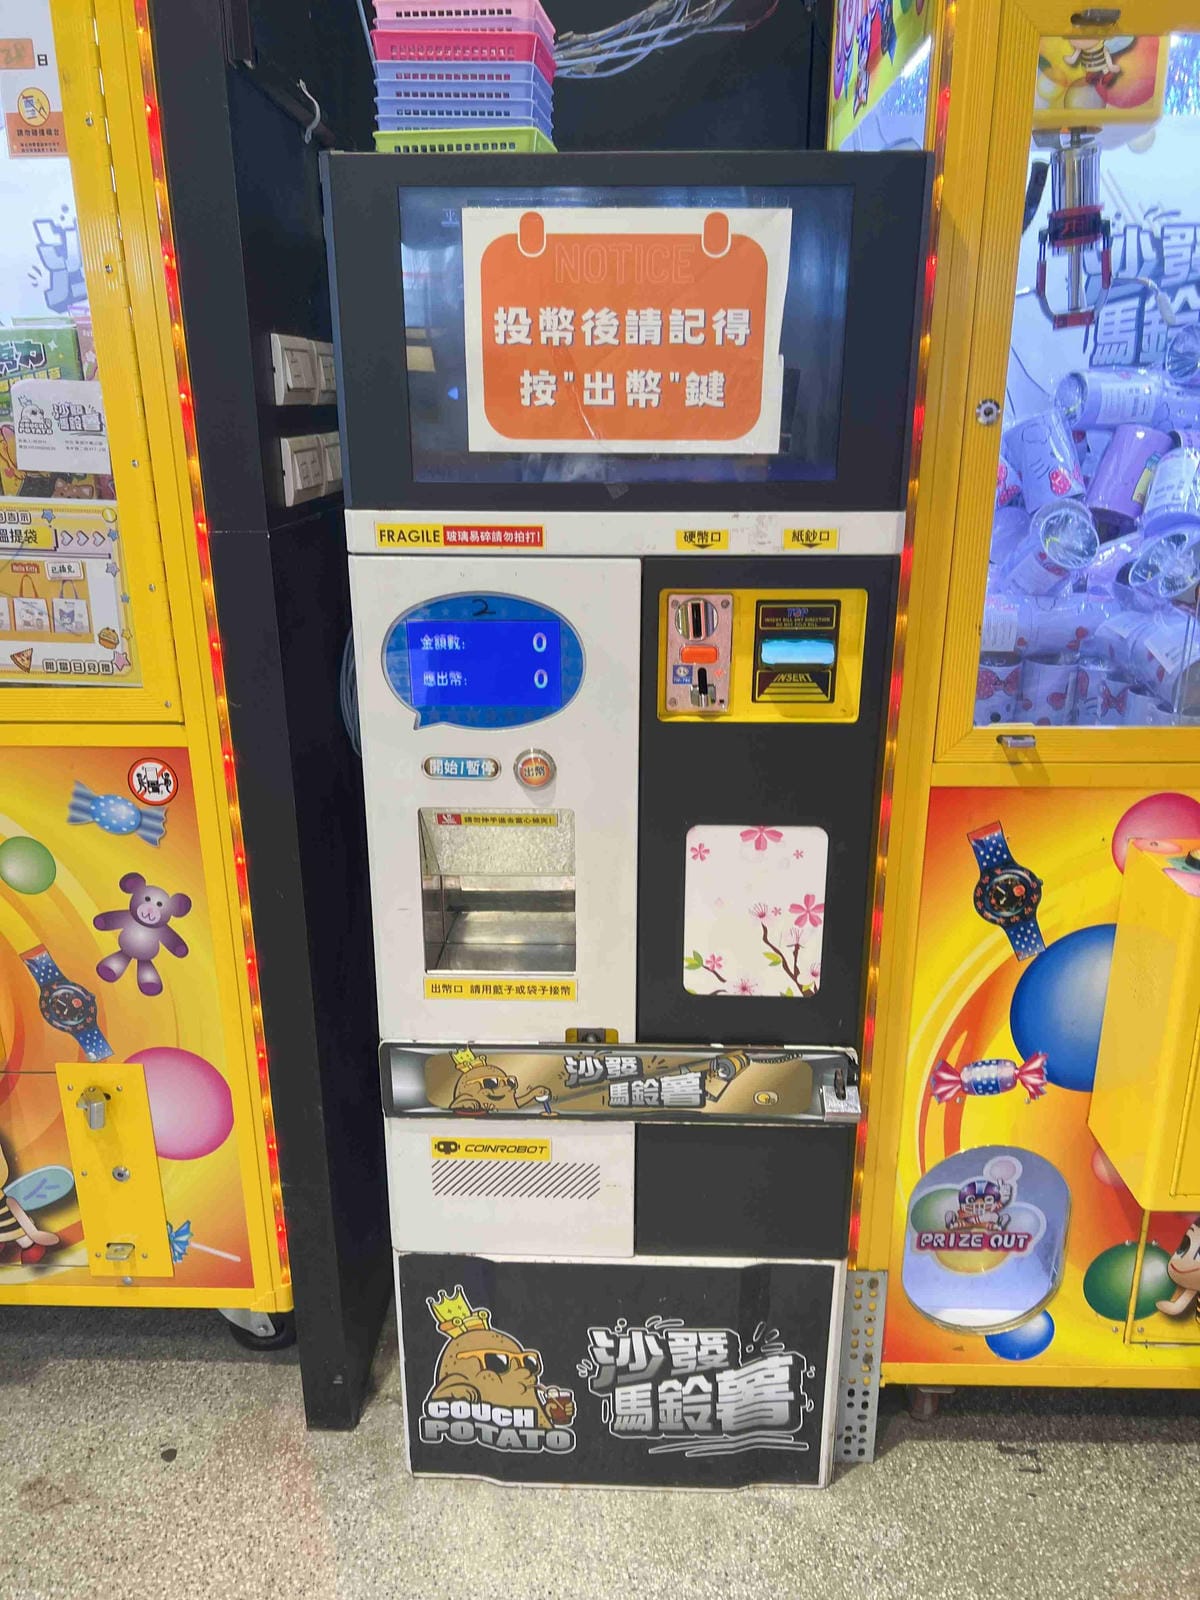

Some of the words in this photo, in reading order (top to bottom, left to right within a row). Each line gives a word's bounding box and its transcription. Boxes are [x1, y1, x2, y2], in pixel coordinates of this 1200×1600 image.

[554, 242, 696, 285] NOTICE
[493, 306, 751, 347] 投幣後請記得
[519, 369, 727, 409] 按"出幣"鍵
[379, 529, 441, 543] FRAGILE
[446, 531, 541, 543] 玻璃易碎請勿拍打!
[683, 530, 721, 543] 硬幣口
[792, 528, 830, 542] 紙鈔口
[472, 598, 496, 617] 2
[532, 632, 547, 652] 0
[534, 669, 548, 689] 0
[773, 673, 812, 682] INSERT
[431, 983, 463, 994] 出幣口
[464, 1144, 548, 1155] COINROBOT
[919, 1233, 984, 1248] PRIZE
[989, 1233, 1029, 1249] OUT
[591, 1329, 730, 1388] 沙發
[613, 1355, 795, 1431] 馬鈴薯
[427, 1401, 535, 1428] COUCH
[424, 1419, 571, 1449] POTATO
